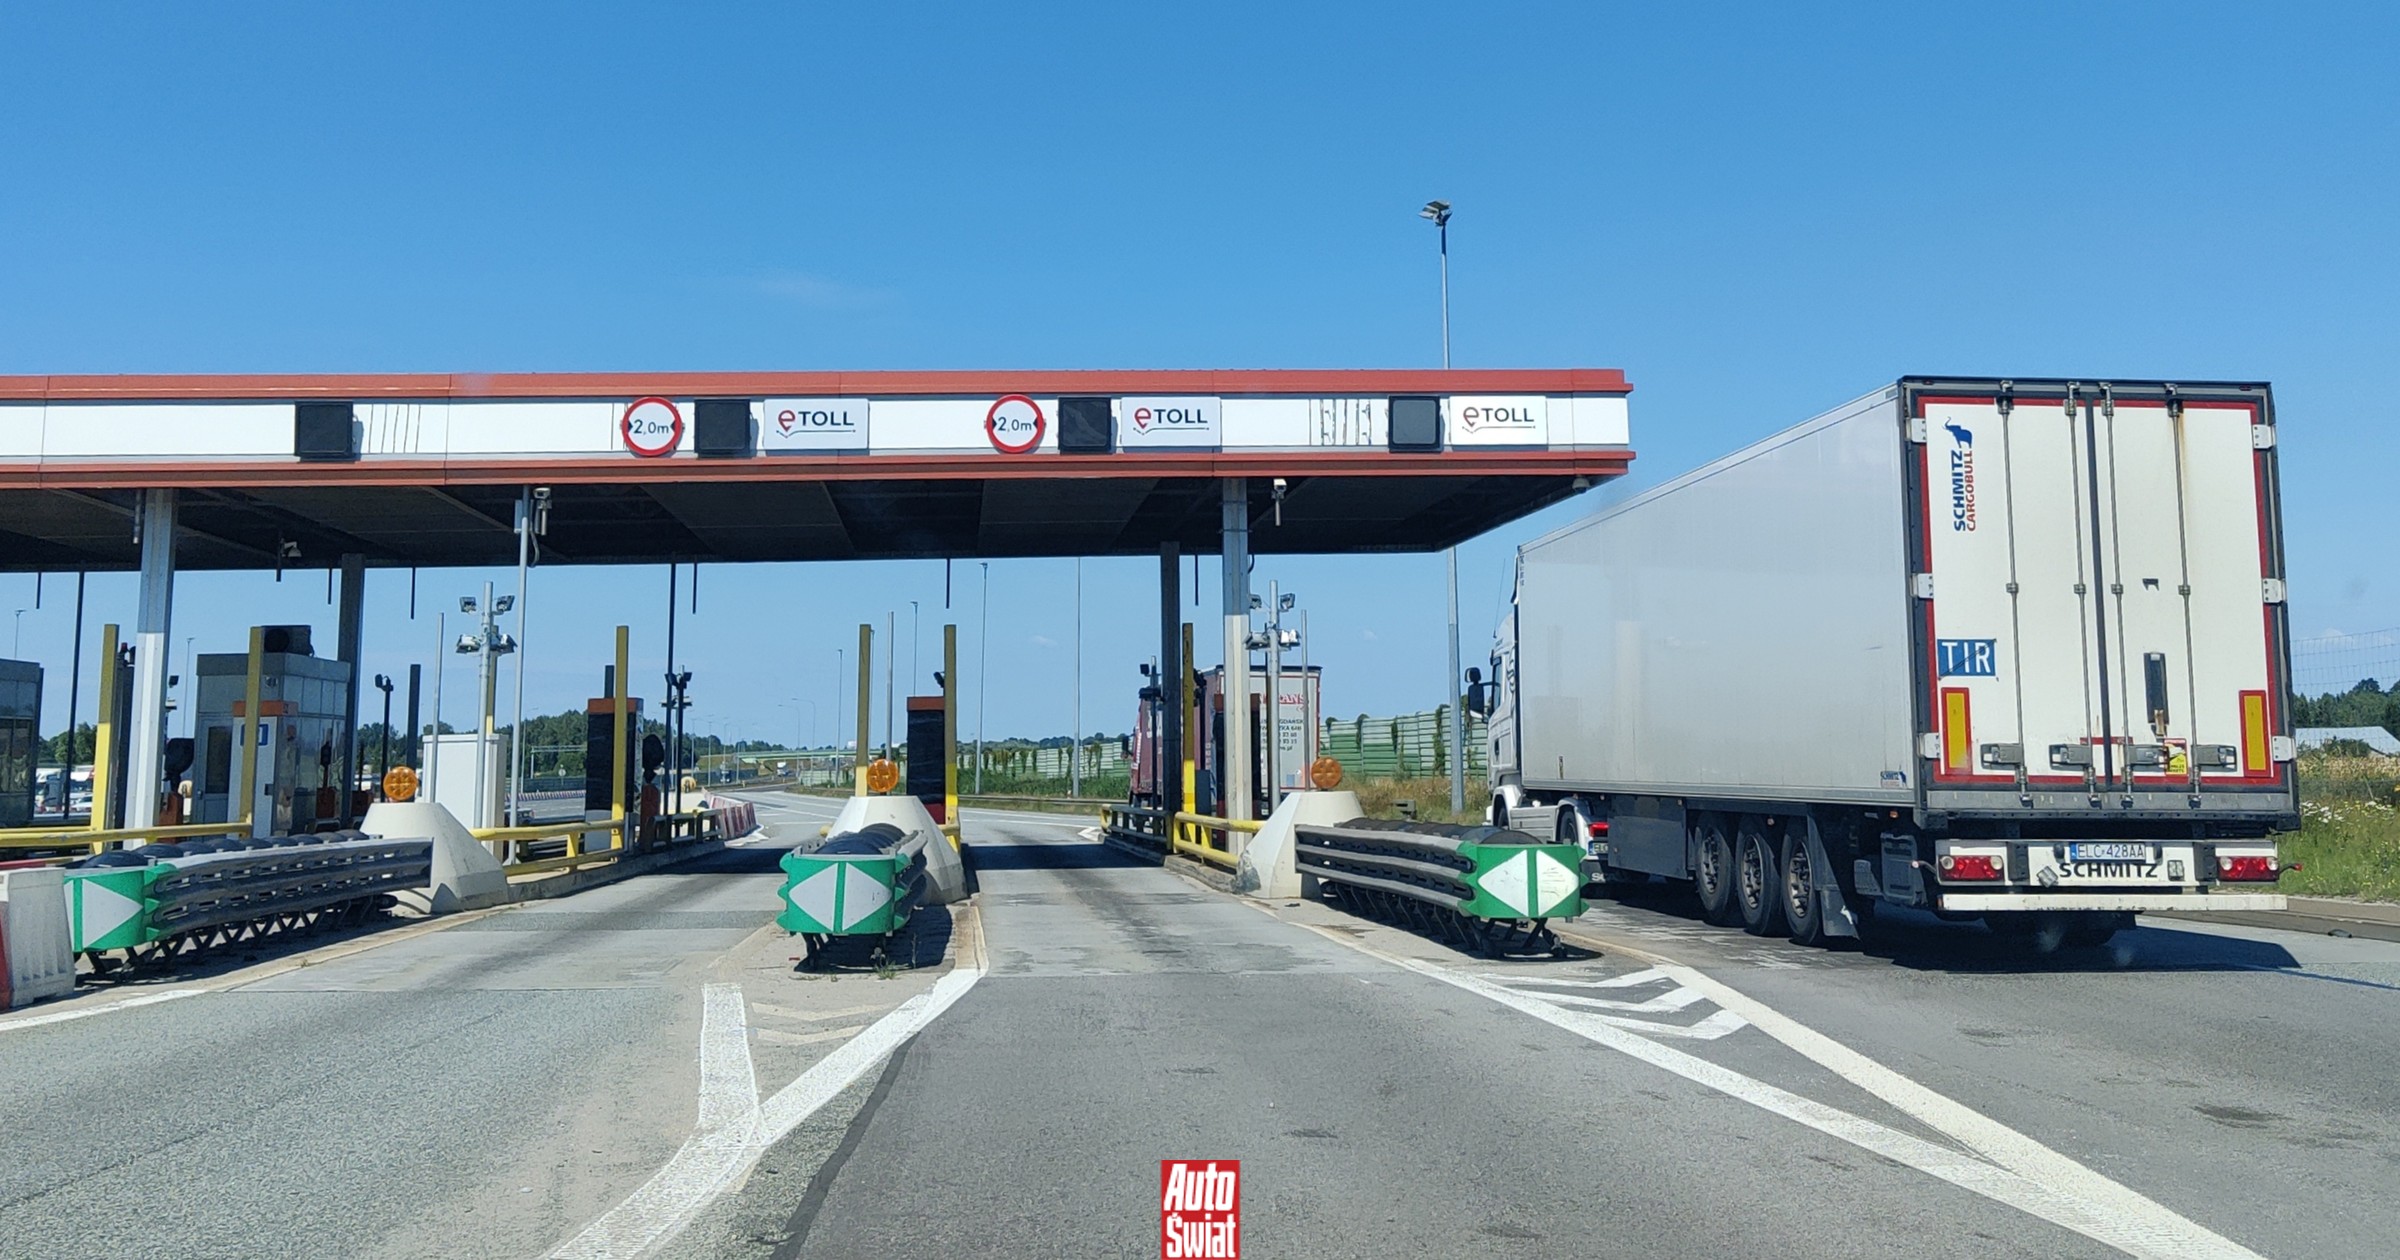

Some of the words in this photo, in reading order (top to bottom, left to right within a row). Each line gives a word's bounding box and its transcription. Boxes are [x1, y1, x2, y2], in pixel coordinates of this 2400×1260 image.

[778, 410, 854, 432] eTOLL
[1134, 408, 1208, 429] eTOLL
[1463, 407, 1535, 427] eTOLL
[1951, 449, 1966, 531] SCHMITZ
[1963, 450, 1976, 531] CARGOBULL
[1941, 641, 1991, 673] TIR
[2077, 844, 2101, 858] ELC
[2106, 844, 2145, 858] 428AA
[2059, 862, 2158, 878] SCHMITZ
